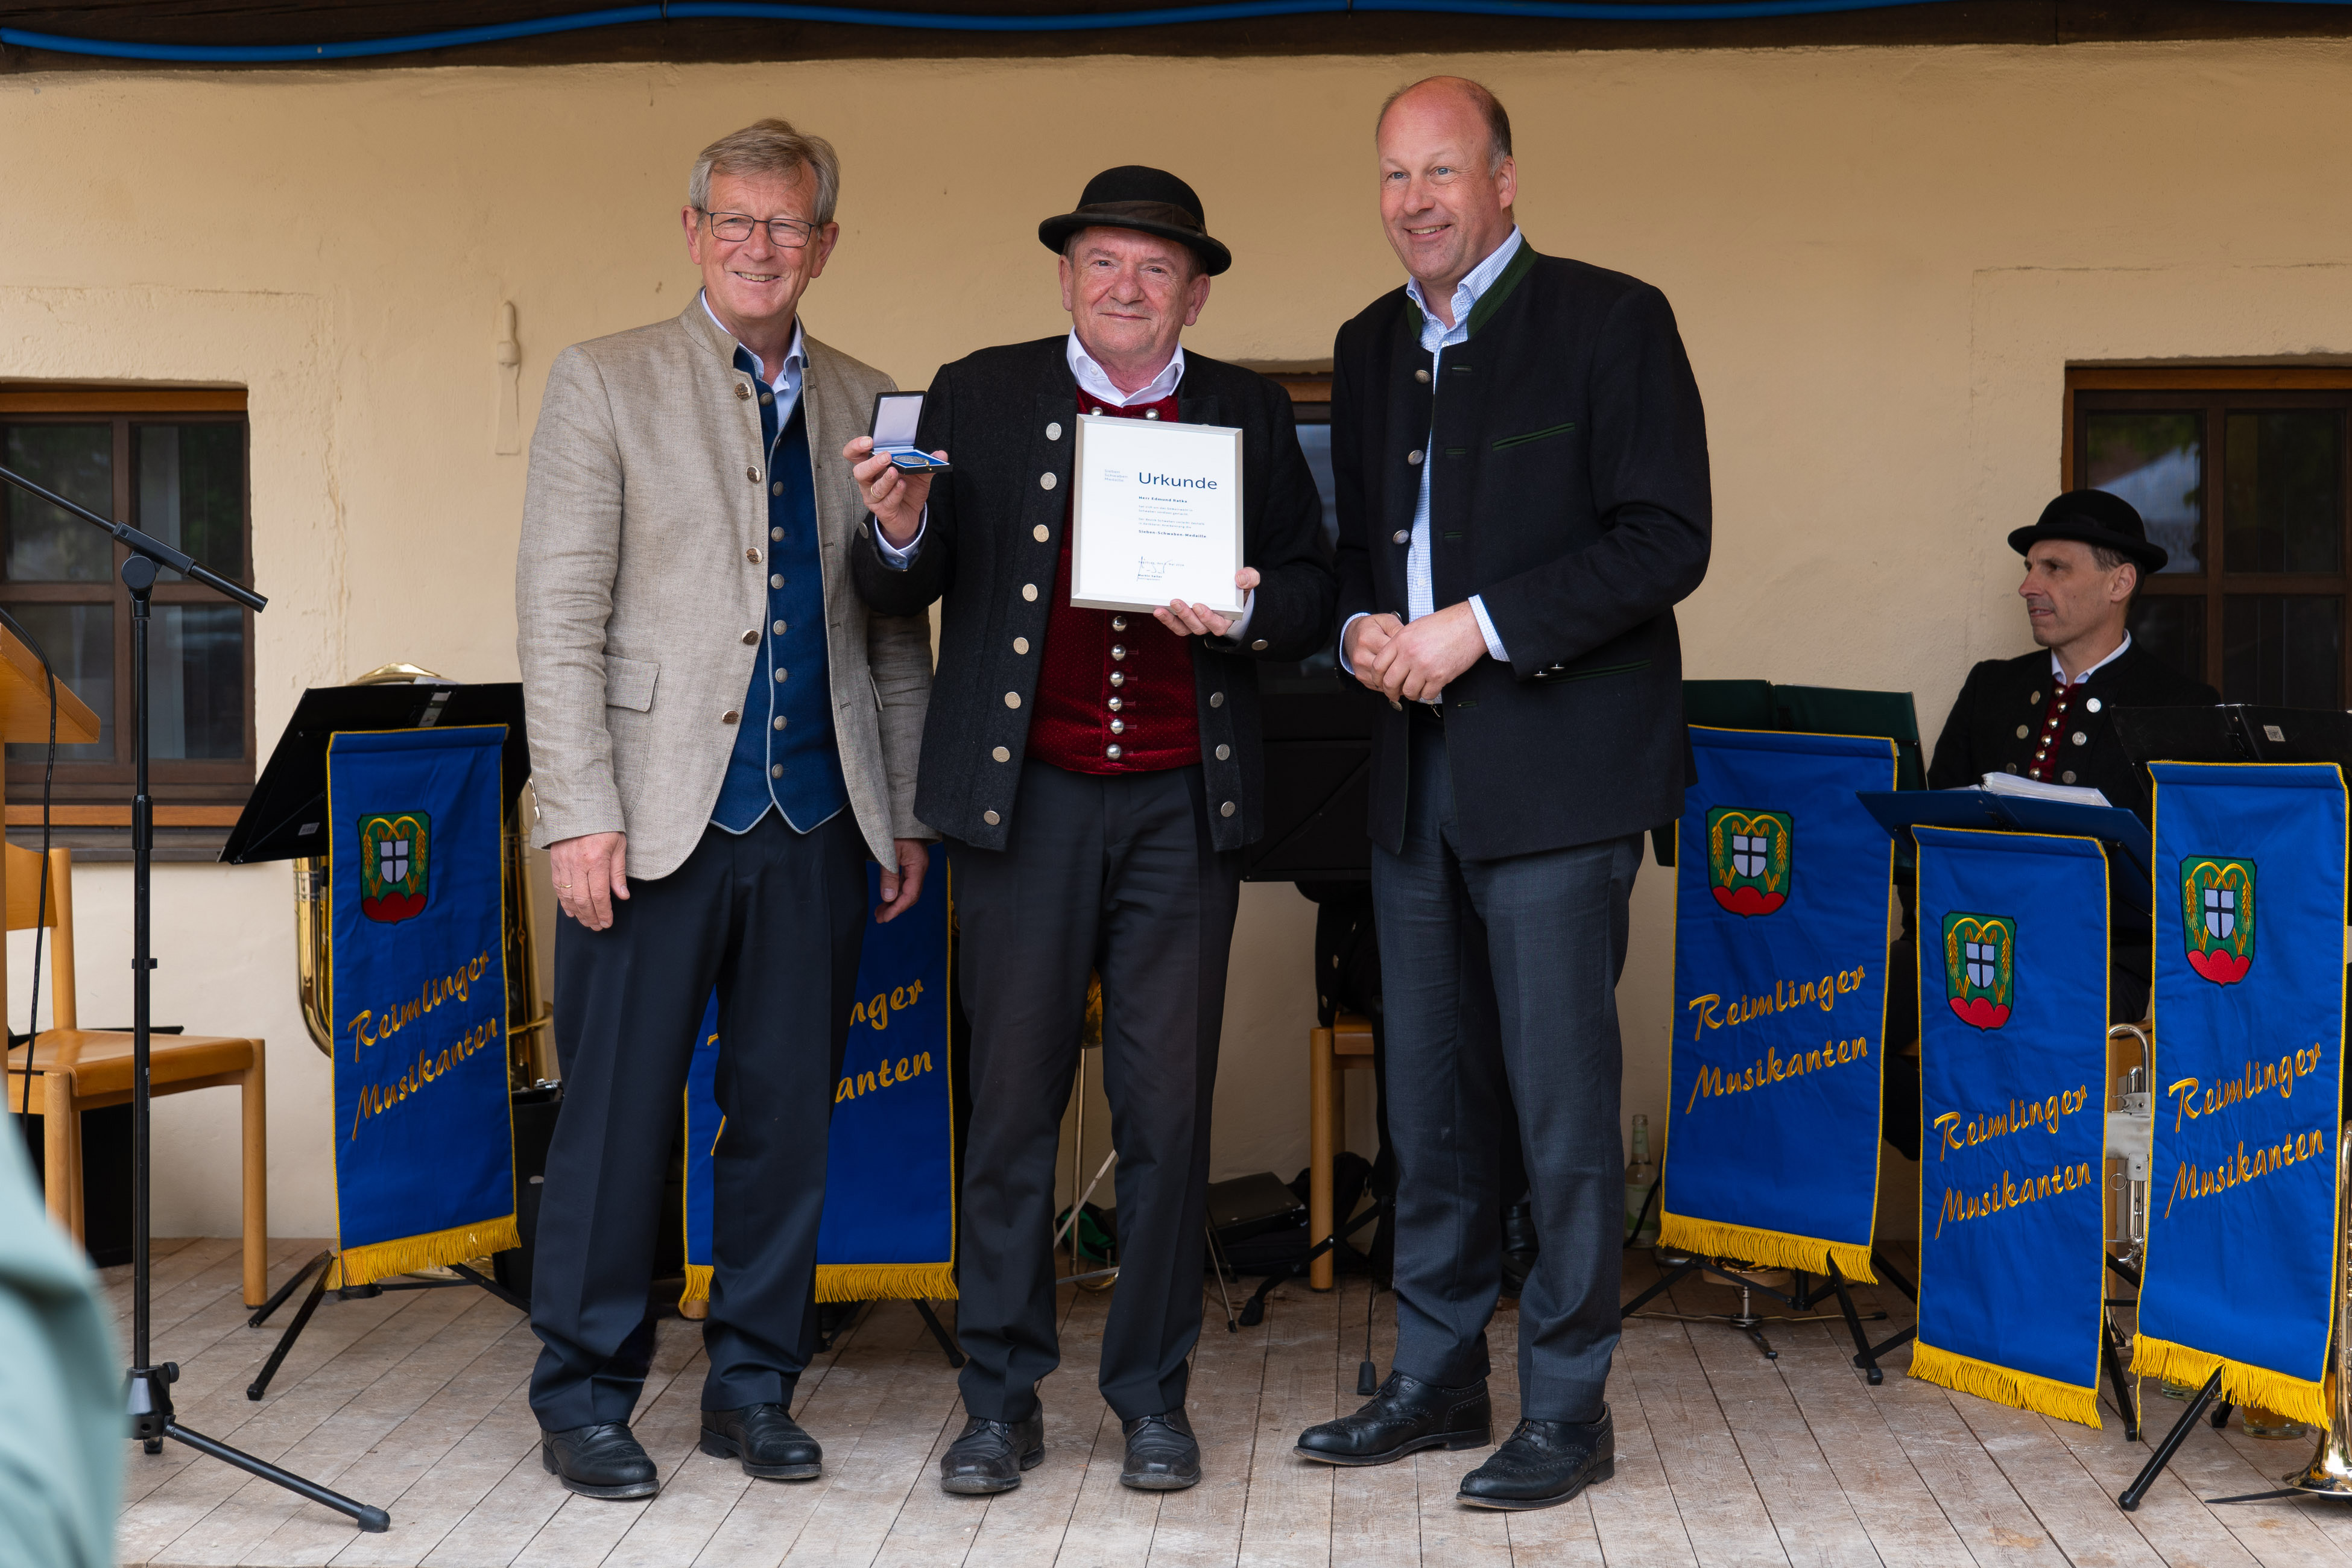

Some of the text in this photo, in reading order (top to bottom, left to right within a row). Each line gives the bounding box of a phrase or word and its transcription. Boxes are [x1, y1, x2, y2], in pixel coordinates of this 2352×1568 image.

[1139, 472, 1218, 490] Urkunde
[1139, 530, 1206, 538] Sieben-Schwaben-Medaille
[348, 950, 489, 1063] Reimlinger
[1689, 966, 1865, 1041] Reimlinger
[352, 1018, 498, 1141] Musikanten
[1686, 1037, 1868, 1114] Musikanten
[2168, 1043, 2321, 1133] Reimlinger
[1934, 1085, 2087, 1162] Reimlinger
[1935, 1162, 2091, 1240] Musikanten
[2164, 1127, 2324, 1219] Musikanten
